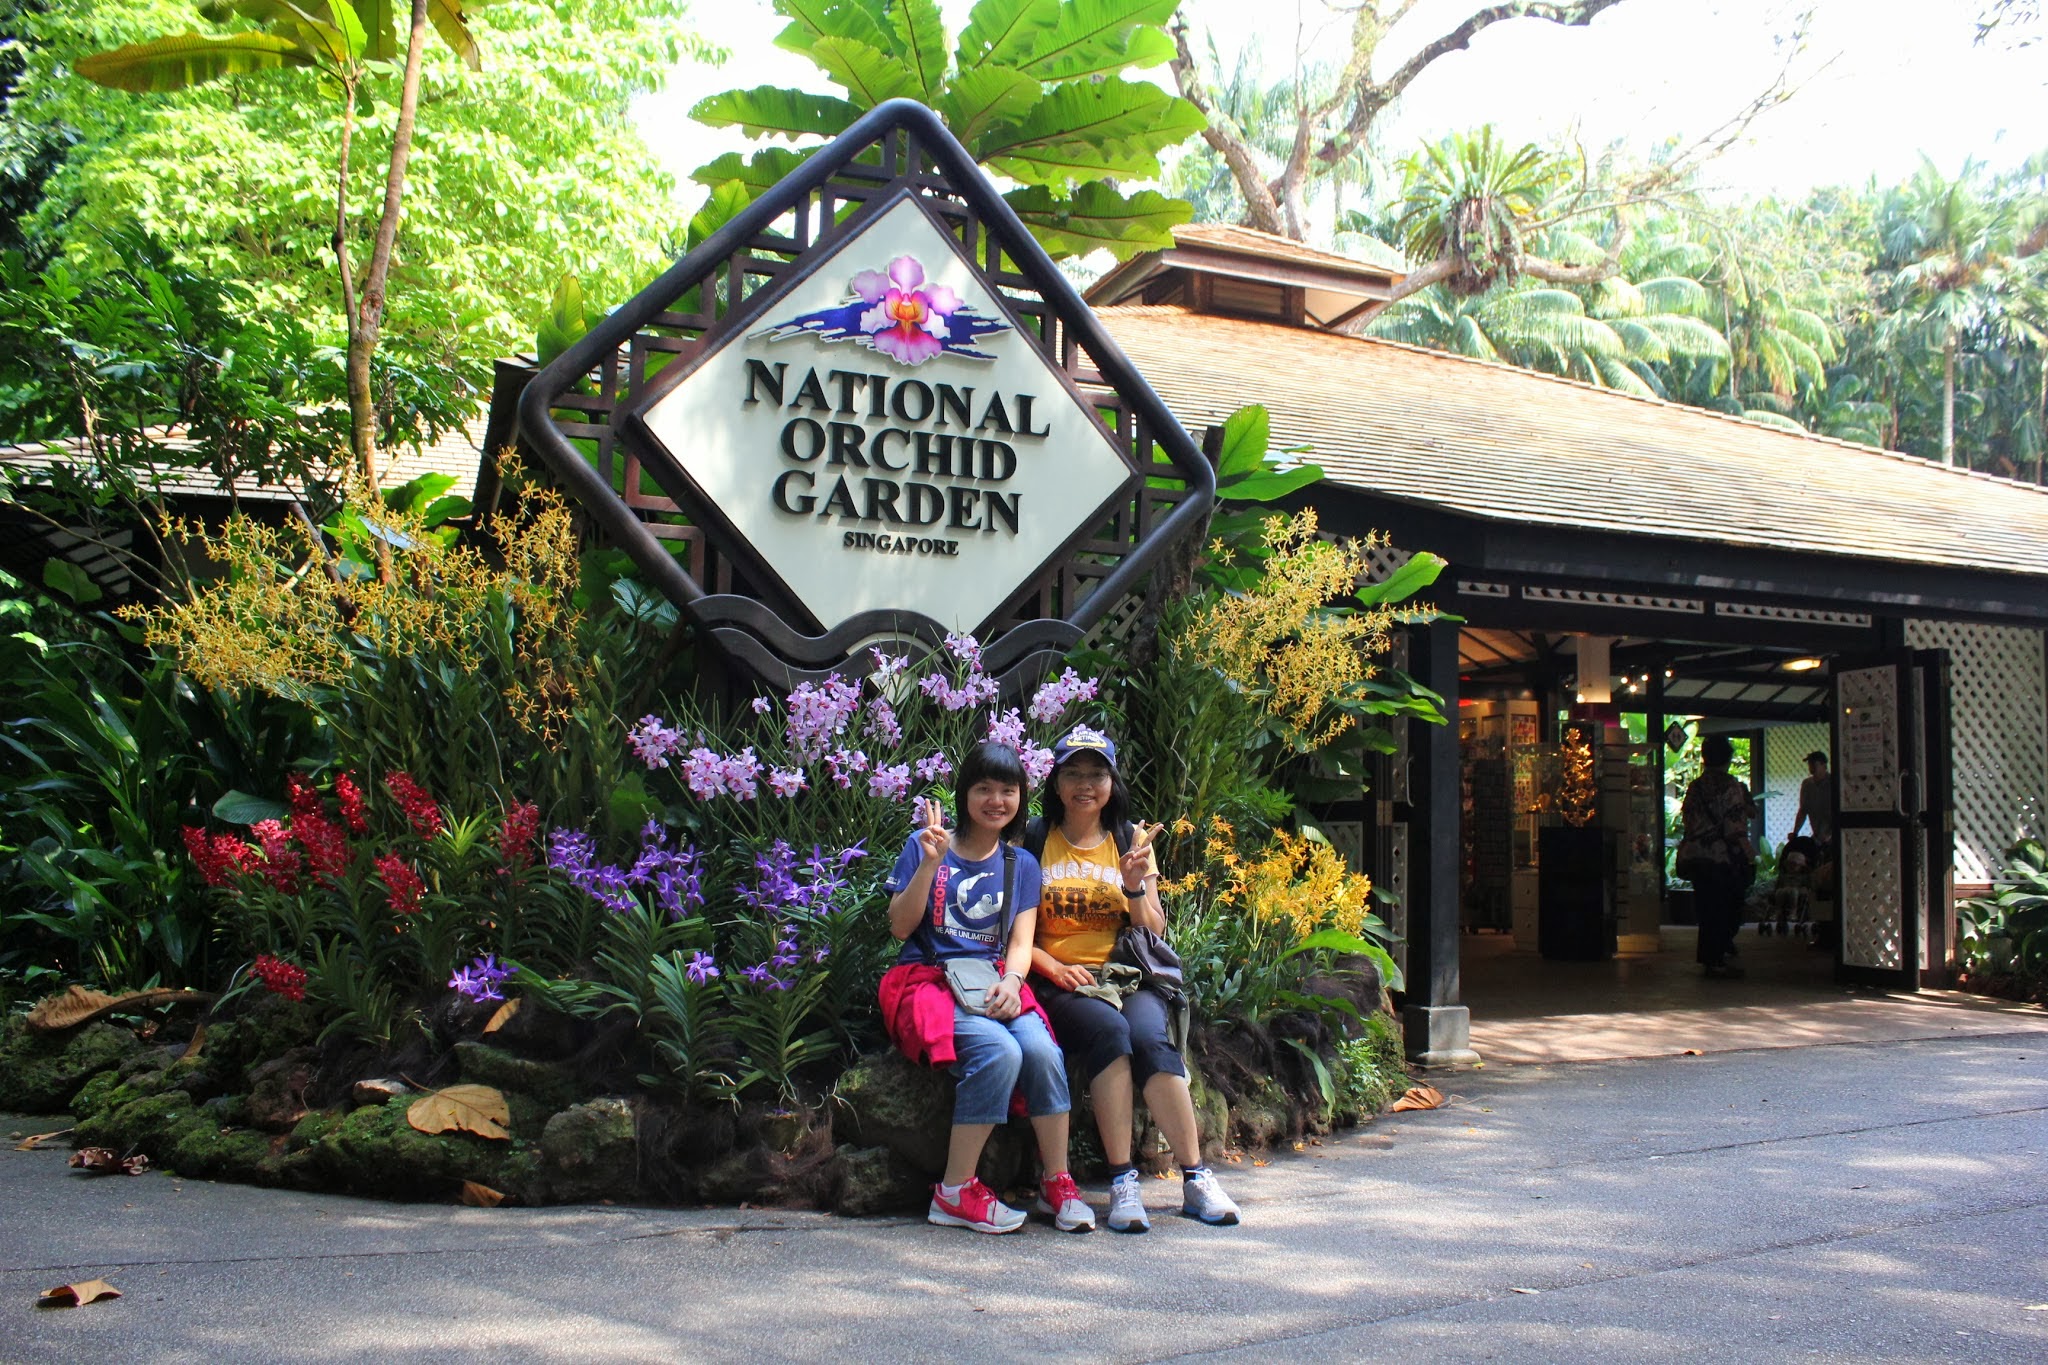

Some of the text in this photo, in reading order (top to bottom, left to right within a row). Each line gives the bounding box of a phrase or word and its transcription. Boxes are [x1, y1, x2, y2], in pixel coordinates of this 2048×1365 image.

[744, 358, 1051, 438] NATIONAL
[780, 417, 1018, 481] ORCHID
[771, 469, 1024, 535] GARDEN
[843, 530, 960, 556] SINGAPORE
[1045, 892, 1088, 915] 38
[935, 926, 995, 943] WE ARE UNLIMITED
